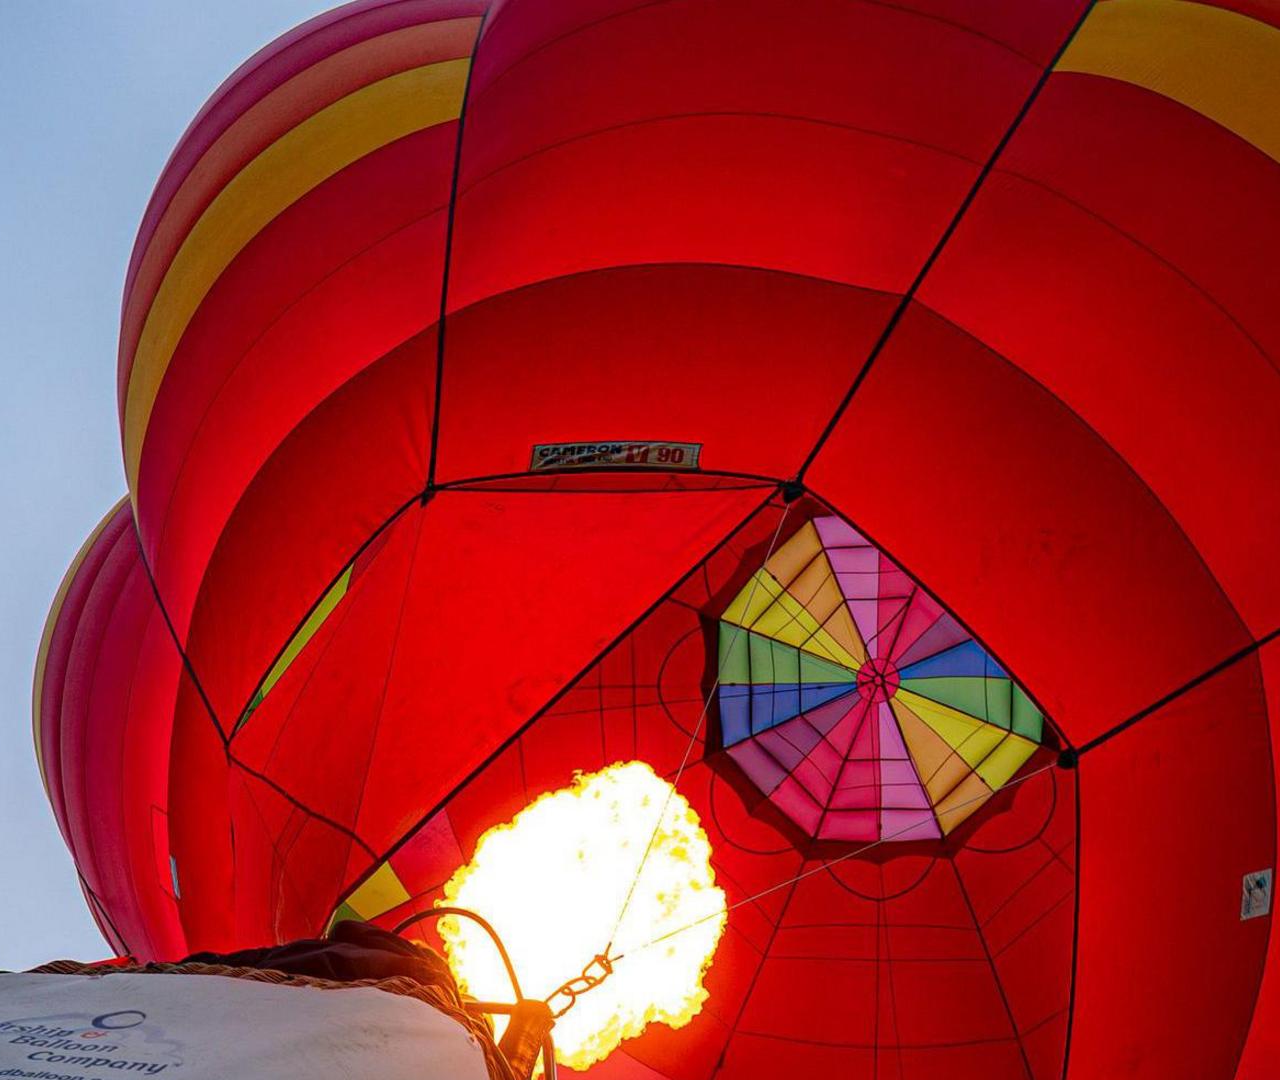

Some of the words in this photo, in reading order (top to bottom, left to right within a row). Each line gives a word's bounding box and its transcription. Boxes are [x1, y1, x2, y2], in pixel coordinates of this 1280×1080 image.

[539, 444, 623, 457] CAMERON
[657, 447, 684, 463] 90
[9, 1035, 118, 1053] Balloon
